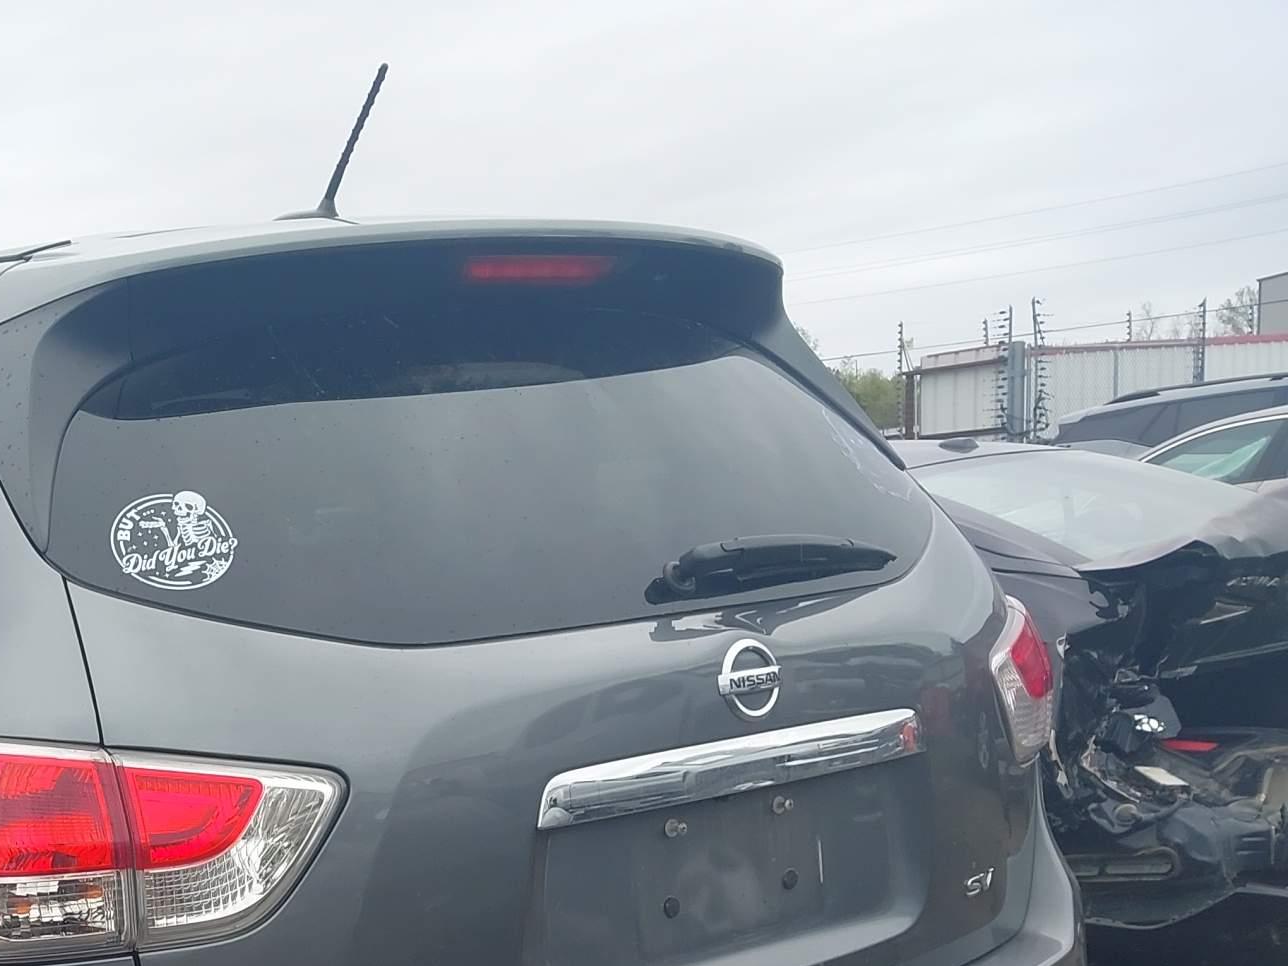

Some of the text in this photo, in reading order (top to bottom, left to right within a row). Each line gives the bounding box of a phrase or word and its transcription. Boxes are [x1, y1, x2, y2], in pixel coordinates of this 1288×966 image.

[123, 536, 238, 574] Did You Die?
[728, 671, 781, 690] NISSAN
